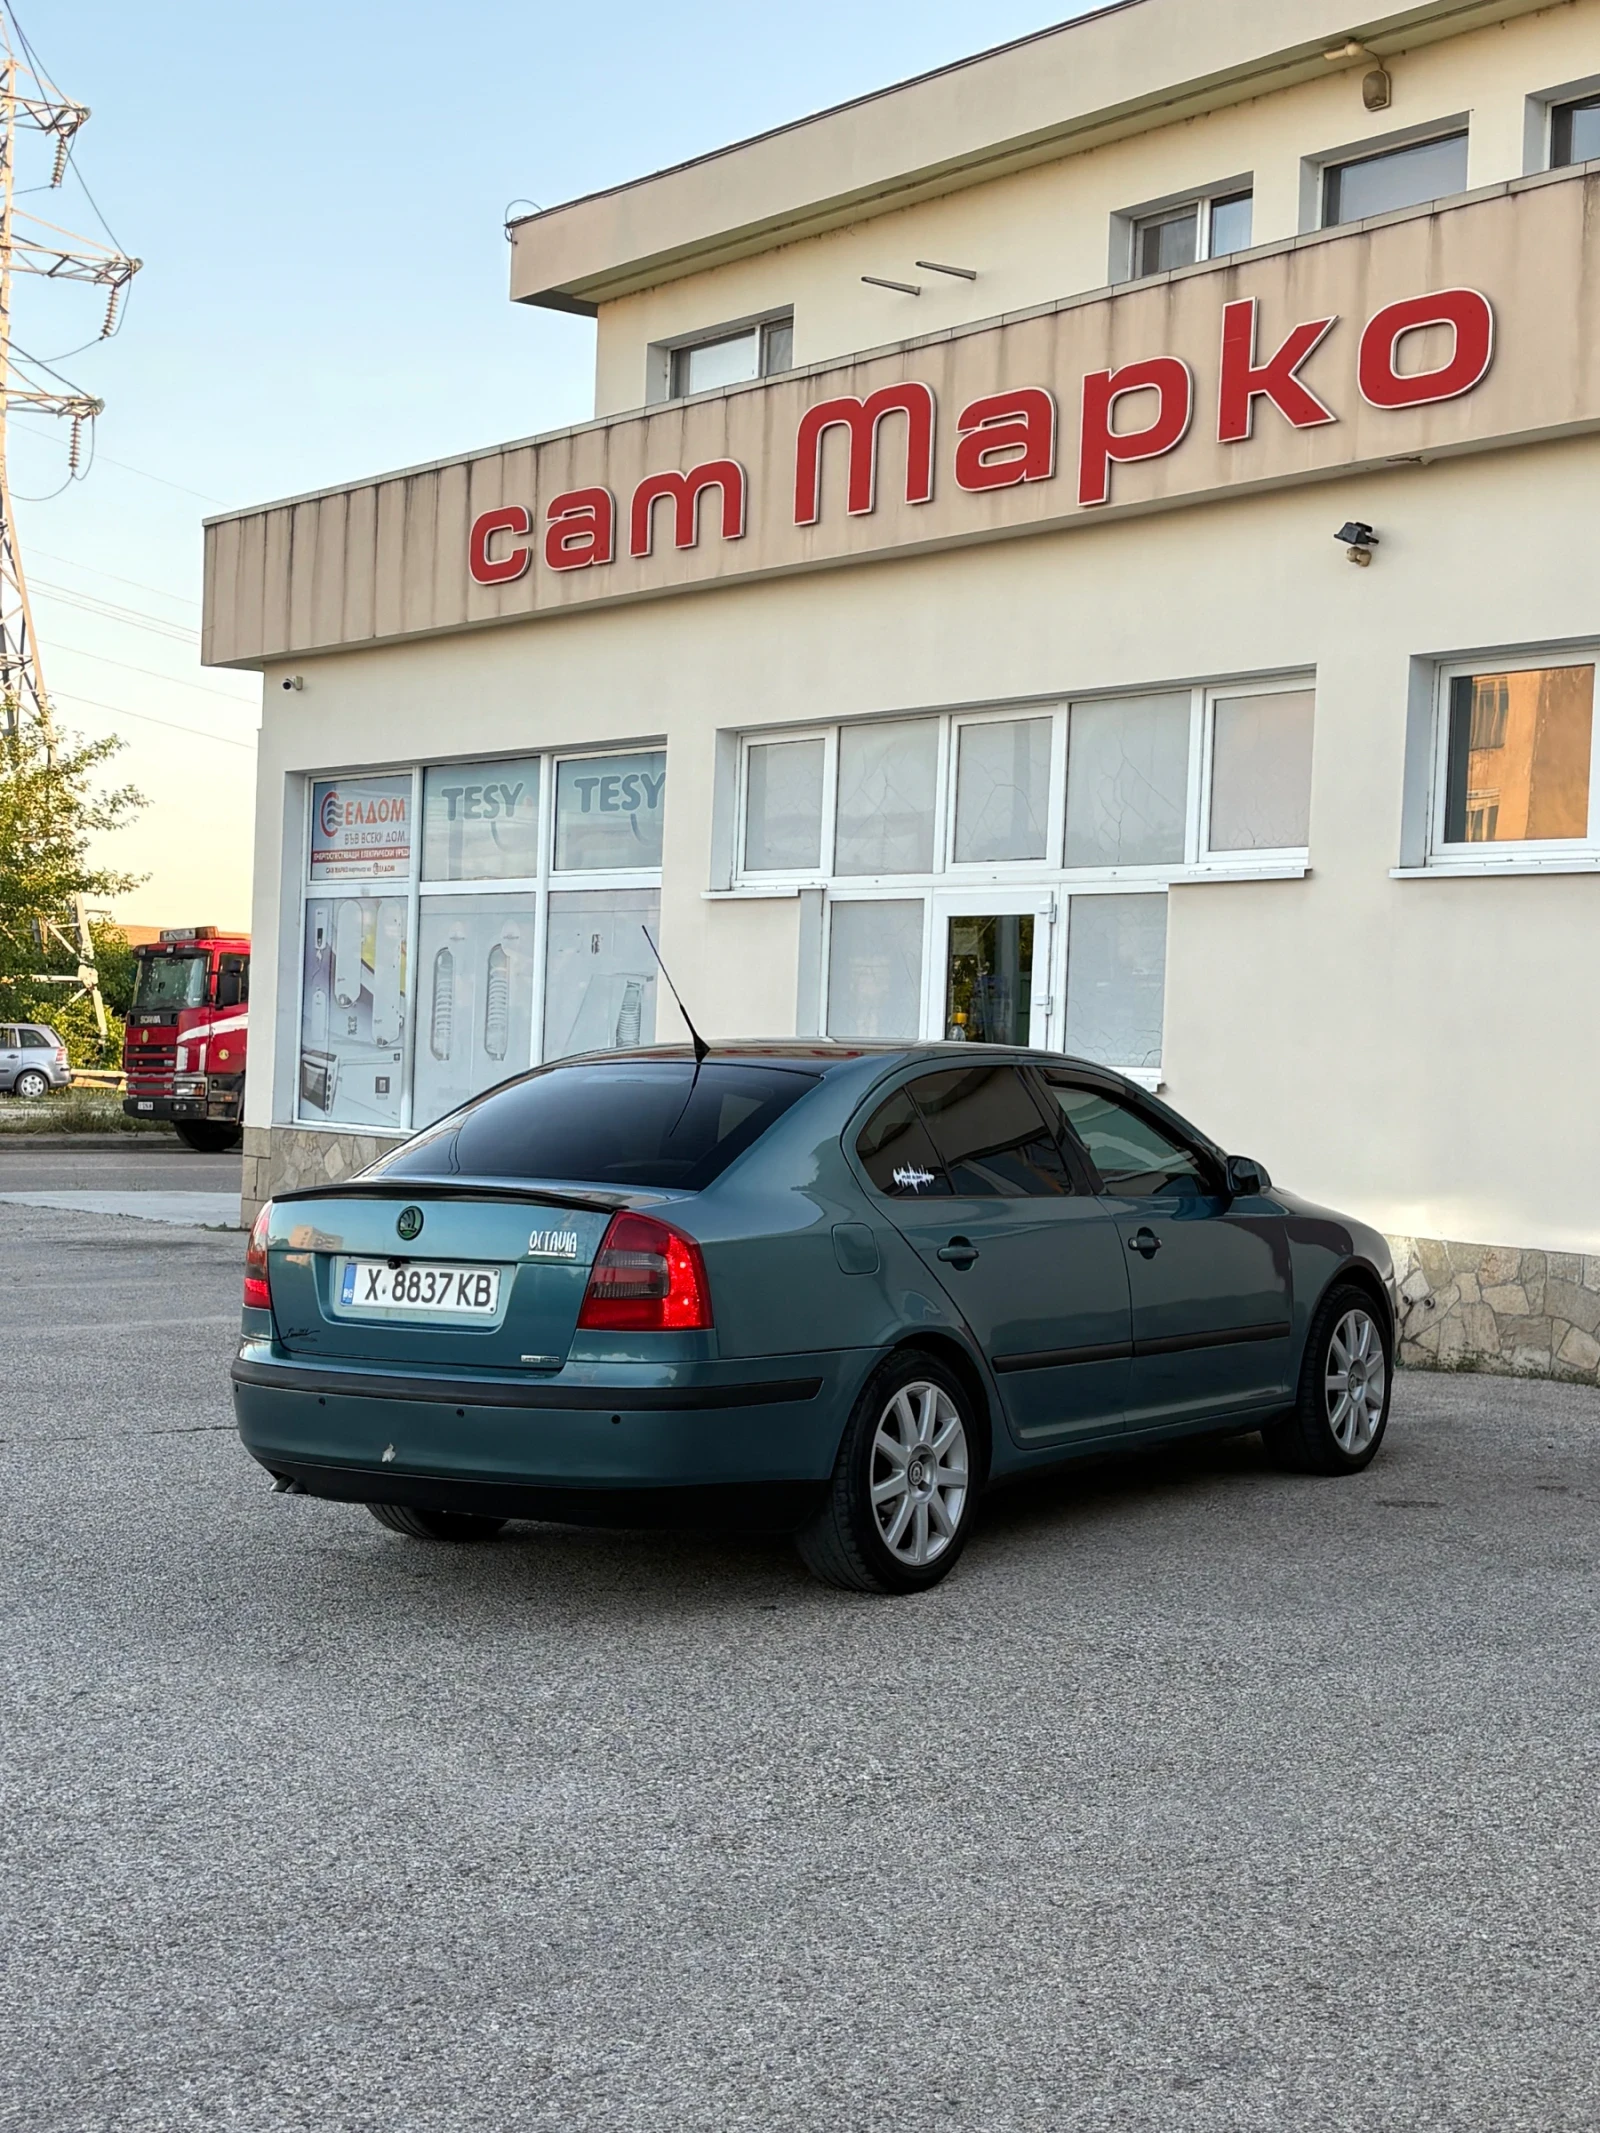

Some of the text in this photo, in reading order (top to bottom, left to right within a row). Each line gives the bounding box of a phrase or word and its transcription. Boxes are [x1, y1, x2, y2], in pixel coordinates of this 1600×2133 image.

[441, 782, 524, 821] TESY
[574, 772, 666, 813] TESY
[365, 1268, 382, 1301] X
[392, 1270, 453, 1304] 8837
[456, 1273, 491, 1307] KB
